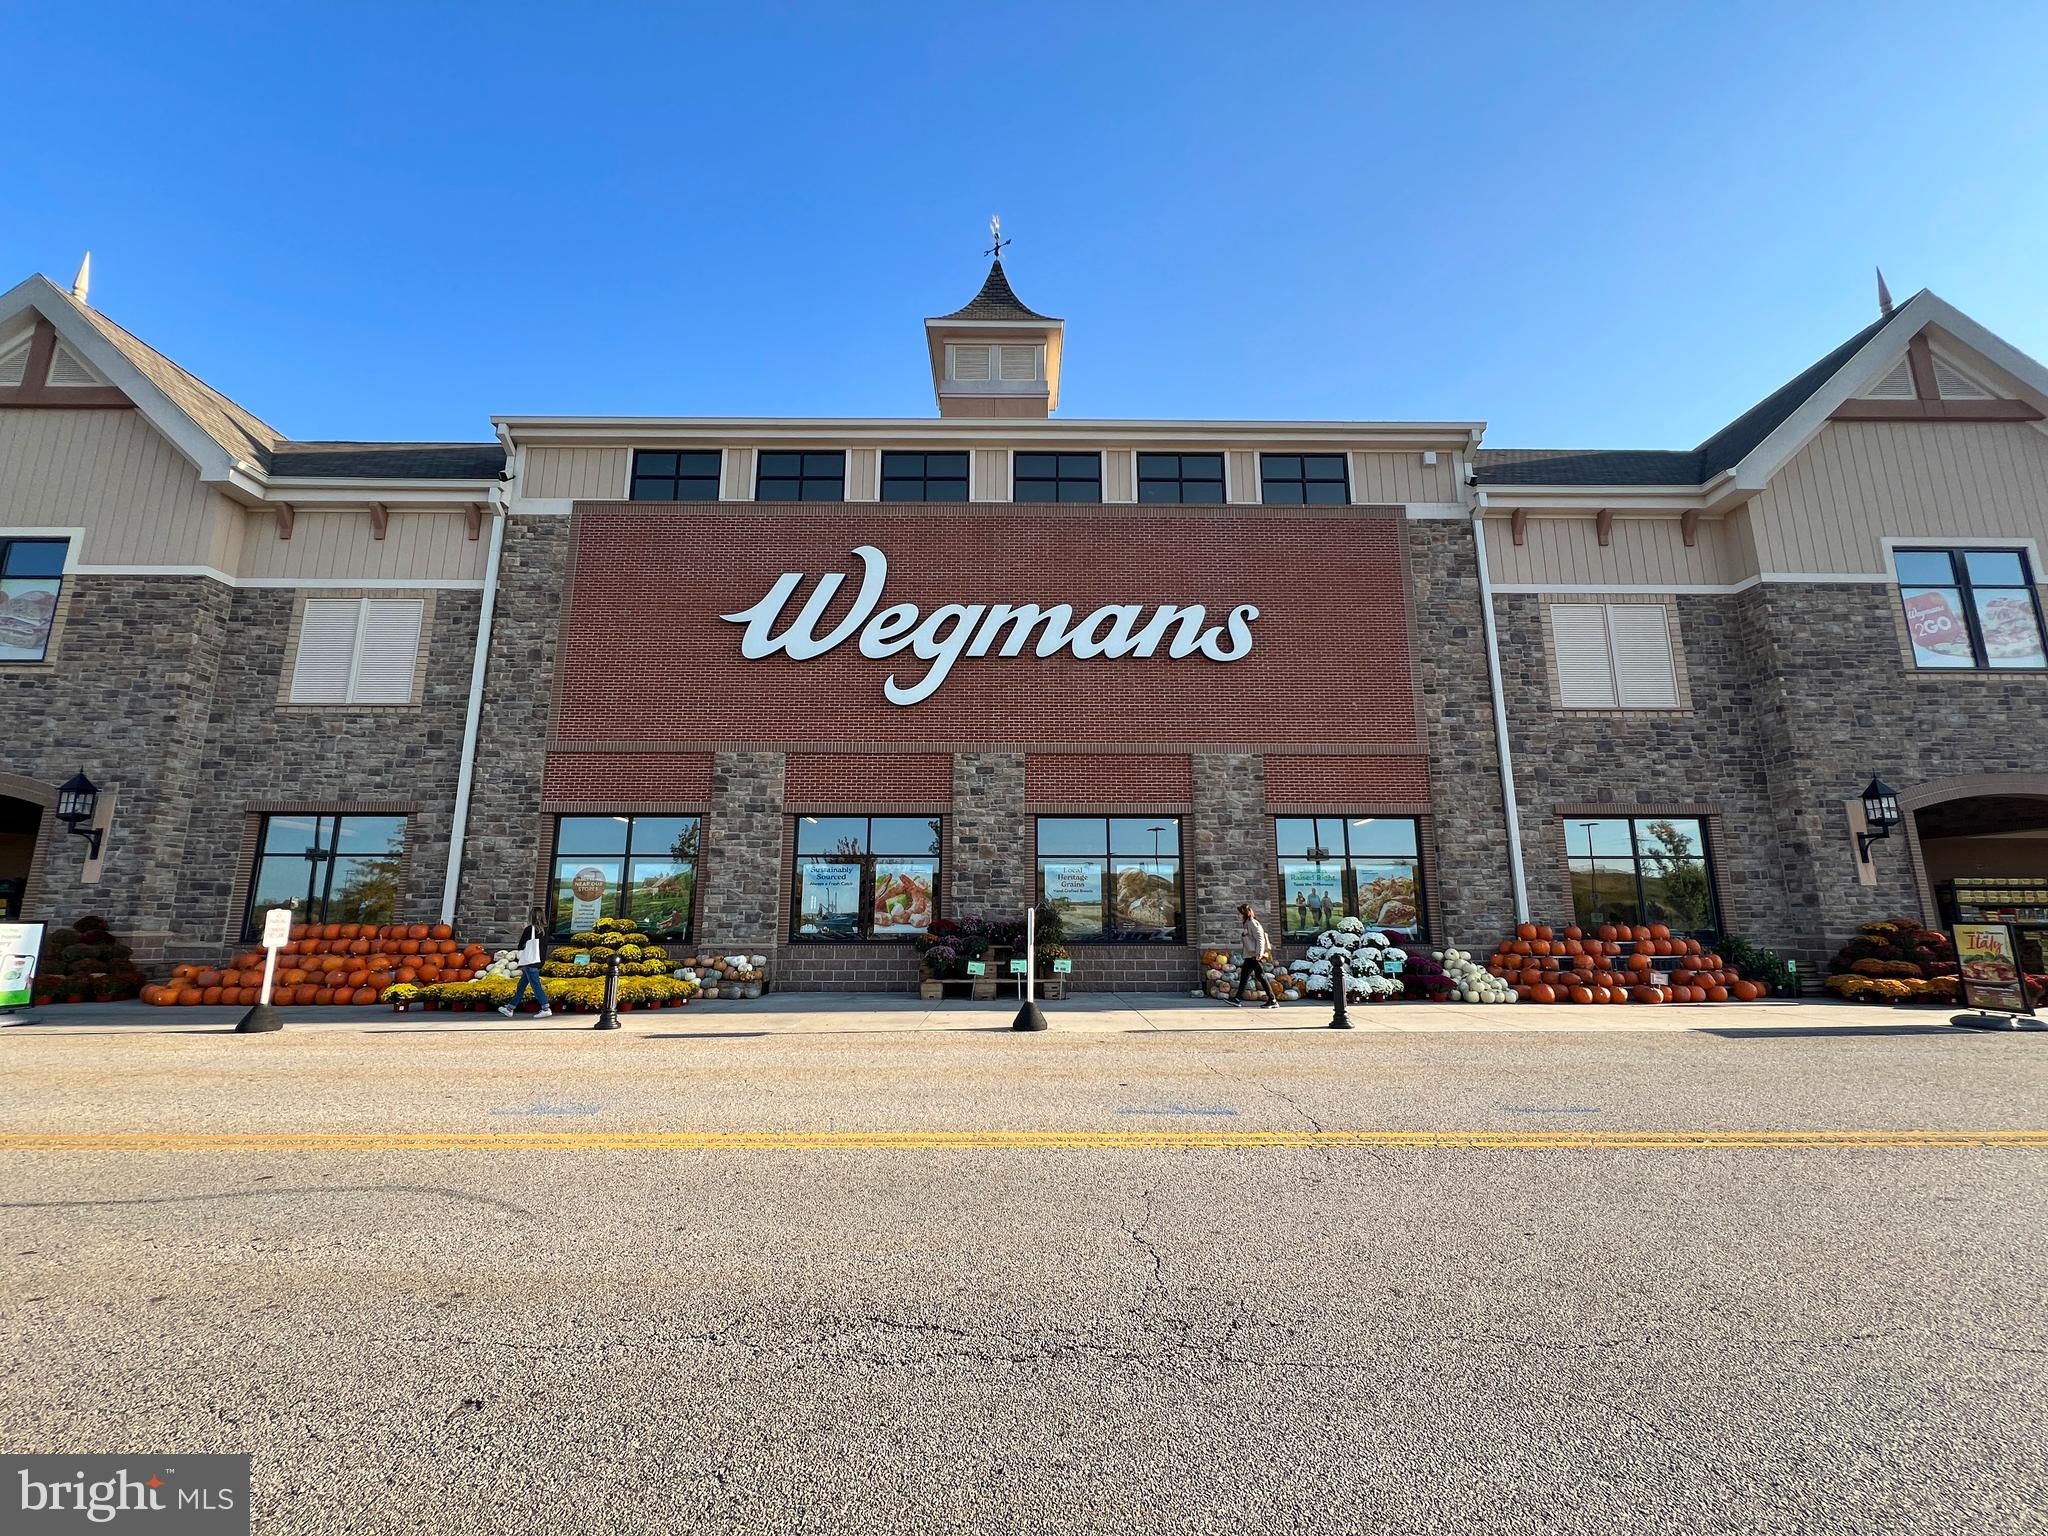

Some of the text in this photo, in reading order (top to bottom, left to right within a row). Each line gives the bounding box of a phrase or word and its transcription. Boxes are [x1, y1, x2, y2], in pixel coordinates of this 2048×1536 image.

[718, 545, 1259, 706] Wegmans
[1915, 615, 1952, 637] 2GO
[810, 866, 853, 874] Sustainably
[1057, 874, 1089, 882] Heritage
[1966, 934, 2004, 955] Italy
